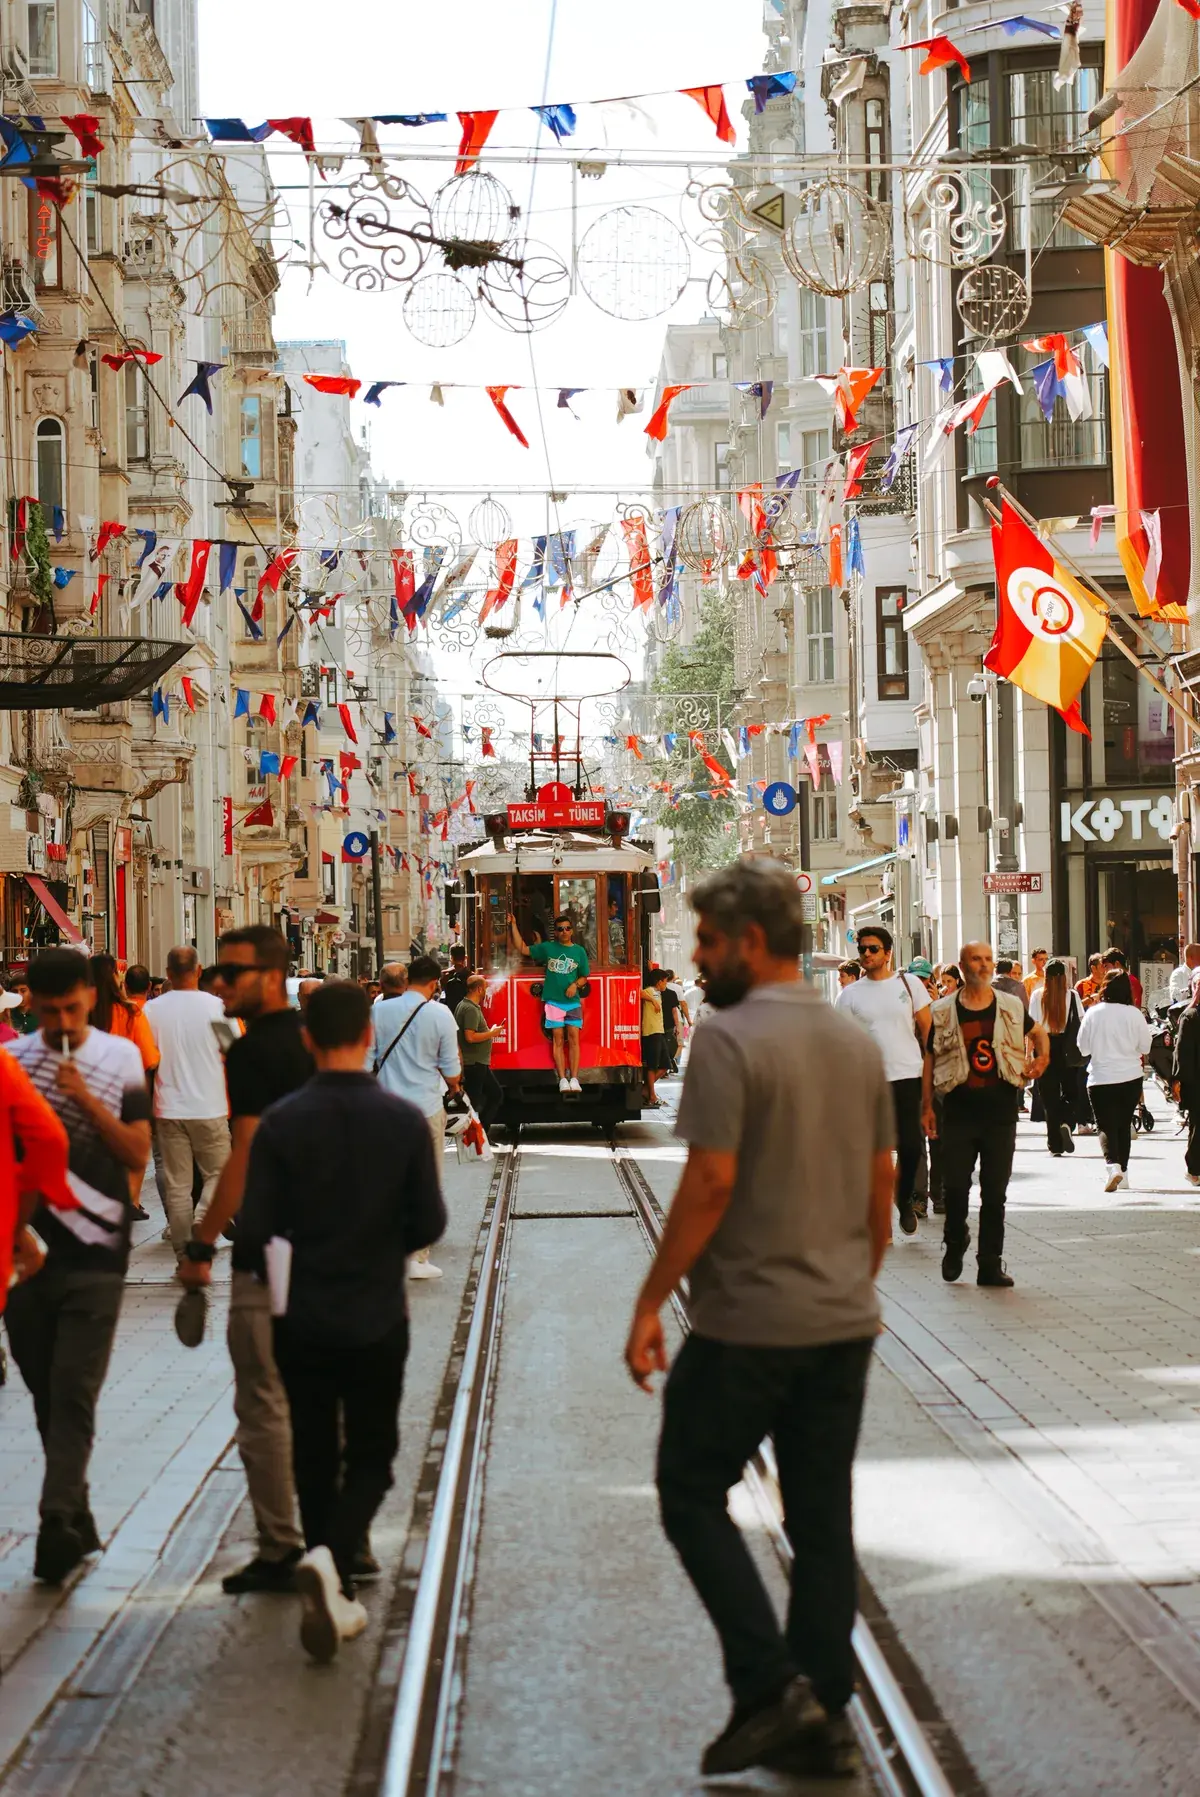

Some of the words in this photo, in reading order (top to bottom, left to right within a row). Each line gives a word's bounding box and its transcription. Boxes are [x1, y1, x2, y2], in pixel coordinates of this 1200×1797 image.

[552, 785, 558, 801] 1
[510, 806, 546, 823] TAKSİM
[569, 806, 601, 821] TÜNEL
[629, 990, 636, 1004] 47
